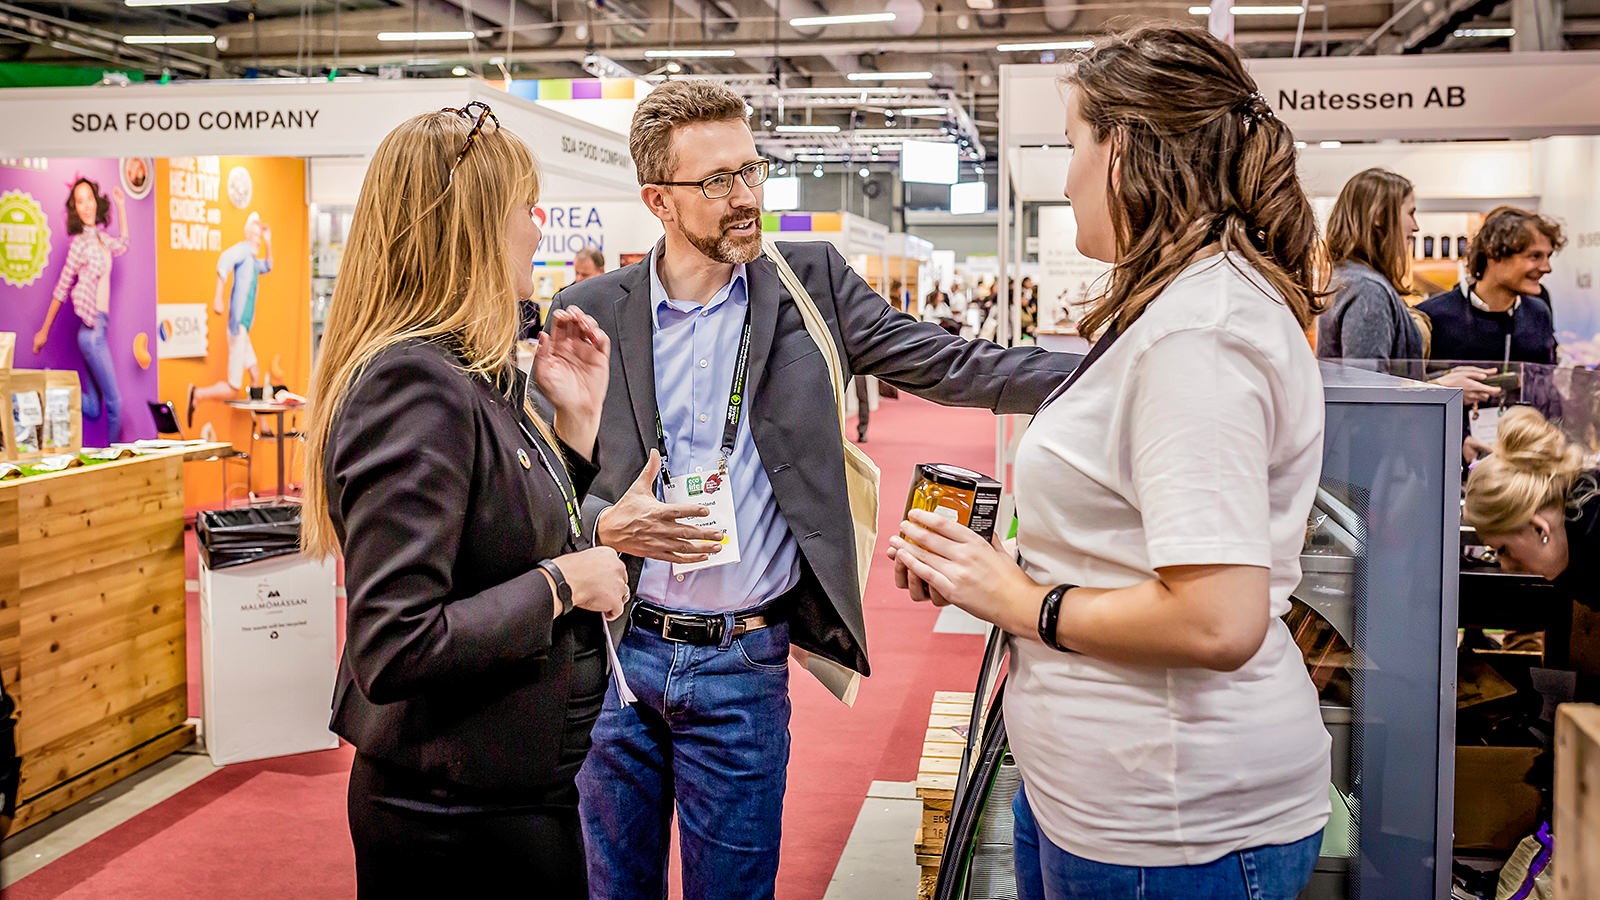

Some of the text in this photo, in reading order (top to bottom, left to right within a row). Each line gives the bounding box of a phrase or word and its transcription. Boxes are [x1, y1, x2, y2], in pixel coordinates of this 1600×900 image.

[1278, 86, 1466, 110] Natessen AB
[72, 109, 319, 132] SDA FOOD COMPANY
